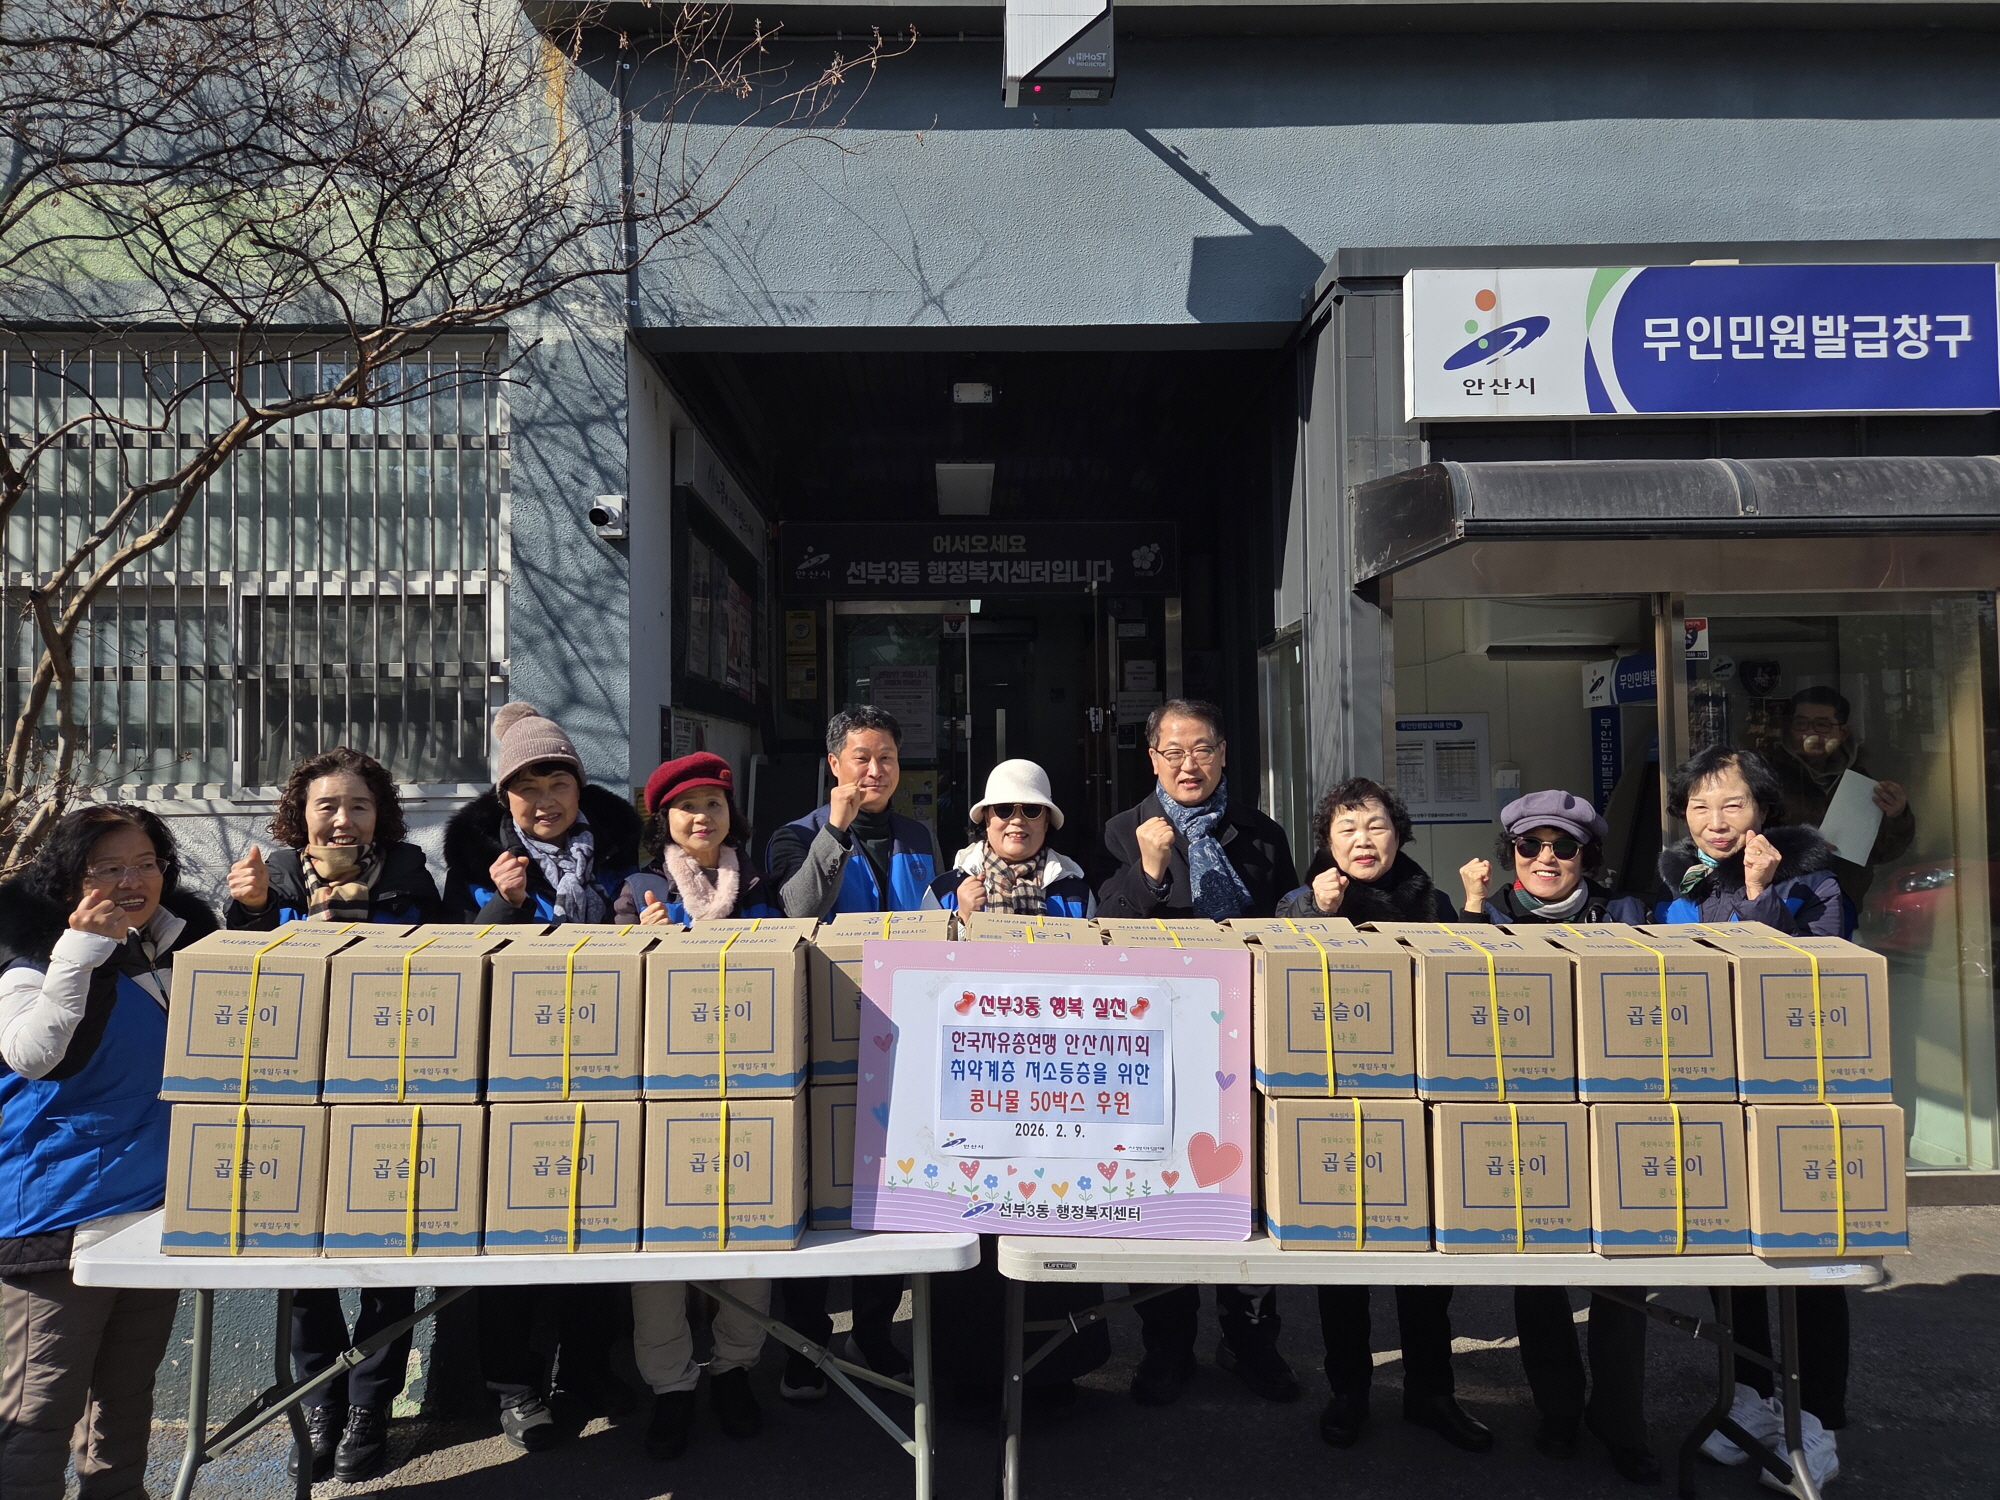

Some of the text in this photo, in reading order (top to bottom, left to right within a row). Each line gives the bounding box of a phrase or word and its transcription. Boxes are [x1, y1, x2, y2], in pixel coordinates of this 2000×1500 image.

[1643, 314, 1972, 361] 무인민원발급창구
[1462, 376, 1536, 396] 안산시
[932, 534, 1026, 554] 어서오세요
[795, 570, 831, 580] 안산시
[846, 560, 1114, 584] 선부3동 행정복지센터입니다
[1004, 929, 1072, 941] 곱슬이
[213, 1003, 278, 1026] 곱슬이
[373, 1005, 436, 1026] 곱슬이
[534, 1003, 596, 1024] 곱슬이
[690, 1000, 751, 1022] 곱슬이
[978, 996, 1128, 1018] 선부3동 행복 실천
[1309, 1000, 1370, 1022] 곱슬이
[1469, 1004, 1530, 1026] 곱슬이
[1625, 1004, 1688, 1025] 곱슬이
[1785, 1005, 1847, 1027] 곱슬이
[387, 1037, 420, 1048] 콩물
[705, 1032, 737, 1044] 콩물
[951, 1032, 1150, 1056] 한국자유총연맹 안산시지회
[1335, 1032, 1357, 1043] 나물
[1801, 1037, 1834, 1048] 콩물
[258, 1067, 290, 1075] 제일두채
[419, 1067, 450, 1075] 제일두채
[580, 1065, 611, 1073] 제일두채
[737, 1062, 767, 1070] 제일두채
[950, 1060, 1150, 1086] 취약계층 저소등층을 위한
[1357, 1062, 1388, 1070] 제일두채
[1518, 1066, 1548, 1074] 제일두채
[1677, 1066, 1708, 1074] 제일두채
[384, 1083, 418, 1091] 3.5k5%
[970, 1089, 1130, 1115] 콩나물 50박스 후원
[1015, 1123, 1085, 1138] 2026. 2. 9.
[213, 1157, 279, 1179] 곱슬이
[372, 1157, 436, 1179] 곱슬이
[532, 1154, 595, 1176] 곱슬이
[689, 1150, 750, 1172] 곱슬이
[1320, 1151, 1383, 1172] 곱슬이
[1485, 1154, 1546, 1175] 곱슬이
[1640, 1155, 1703, 1176] 곱슬이
[1801, 1158, 1863, 1179] 곱슬이
[1501, 1186, 1533, 1197] 콩물
[578, 1217, 609, 1225] 제일두채
[736, 1213, 766, 1221] 제일두채
[998, 1202, 1141, 1222] 선부3동 행정복지센터
[1370, 1214, 1401, 1222] 제일두채
[1534, 1217, 1564, 1225] 제일두채
[1692, 1218, 1722, 1226] 제일두채
[259, 1221, 291, 1229] 제일두채
[419, 1221, 450, 1229] 제일두채
[1501, 1233, 1535, 1241] 3.5kg5%
